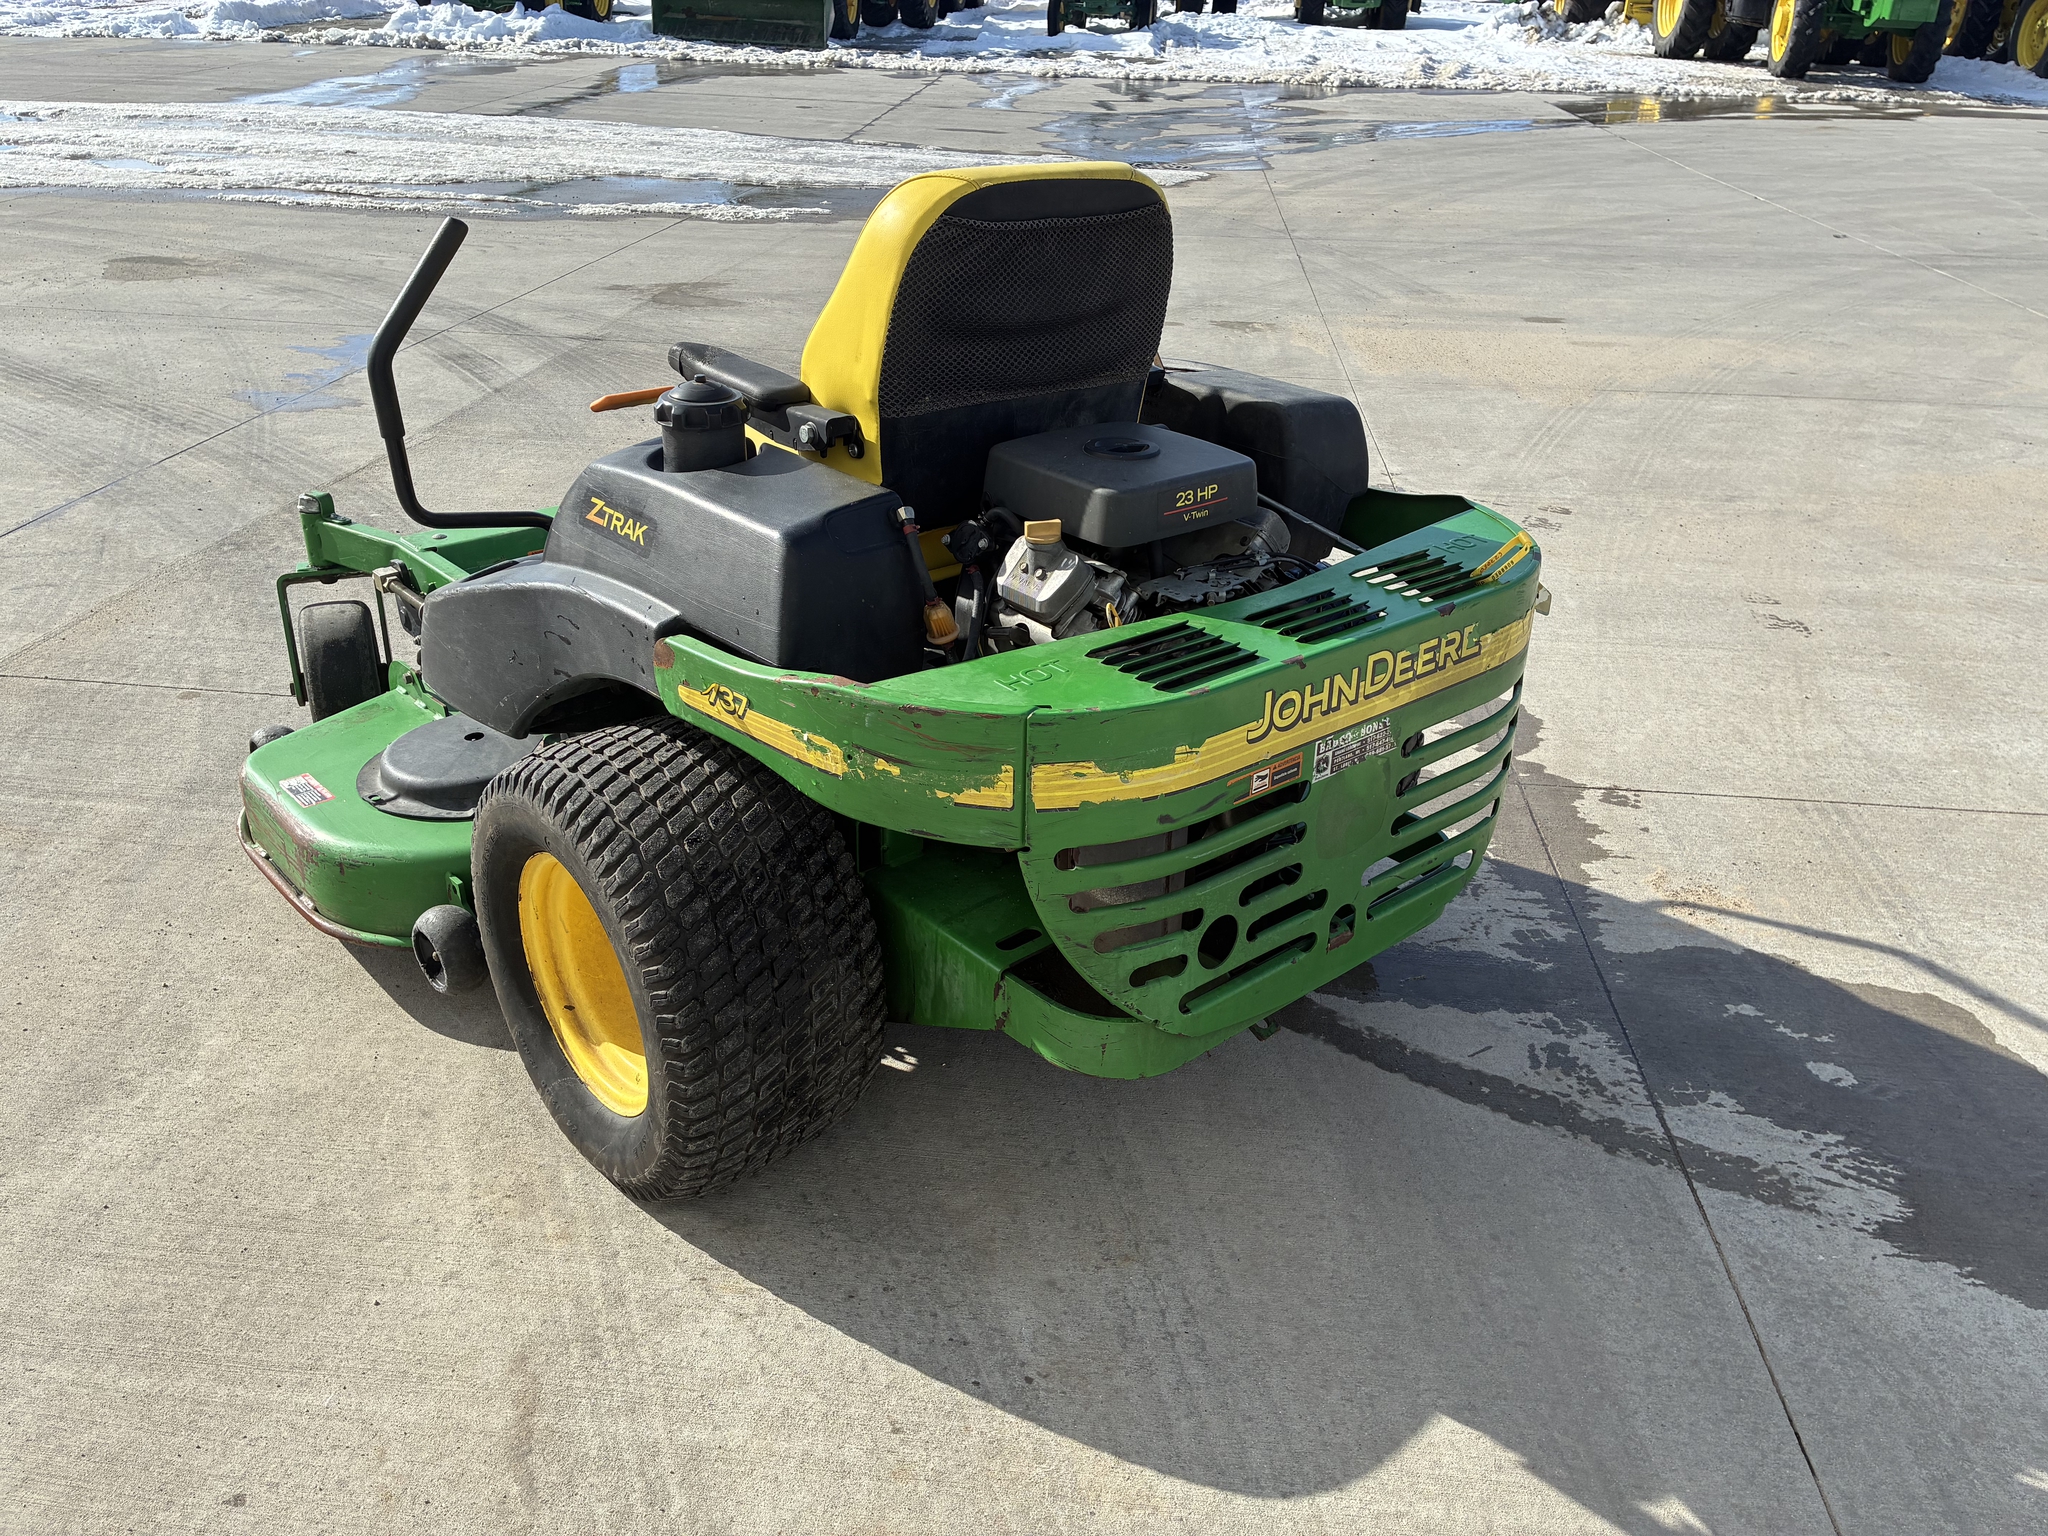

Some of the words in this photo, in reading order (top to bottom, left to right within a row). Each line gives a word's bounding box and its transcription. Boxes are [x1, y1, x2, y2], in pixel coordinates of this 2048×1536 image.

[1176, 489, 1194, 507] 23
[1197, 484, 1218, 502] HP
[1183, 509, 1209, 521] V-Twin
[1432, 534, 1488, 554] HOT
[993, 659, 1070, 692] HOT
[1247, 666, 1361, 744] JOHN
